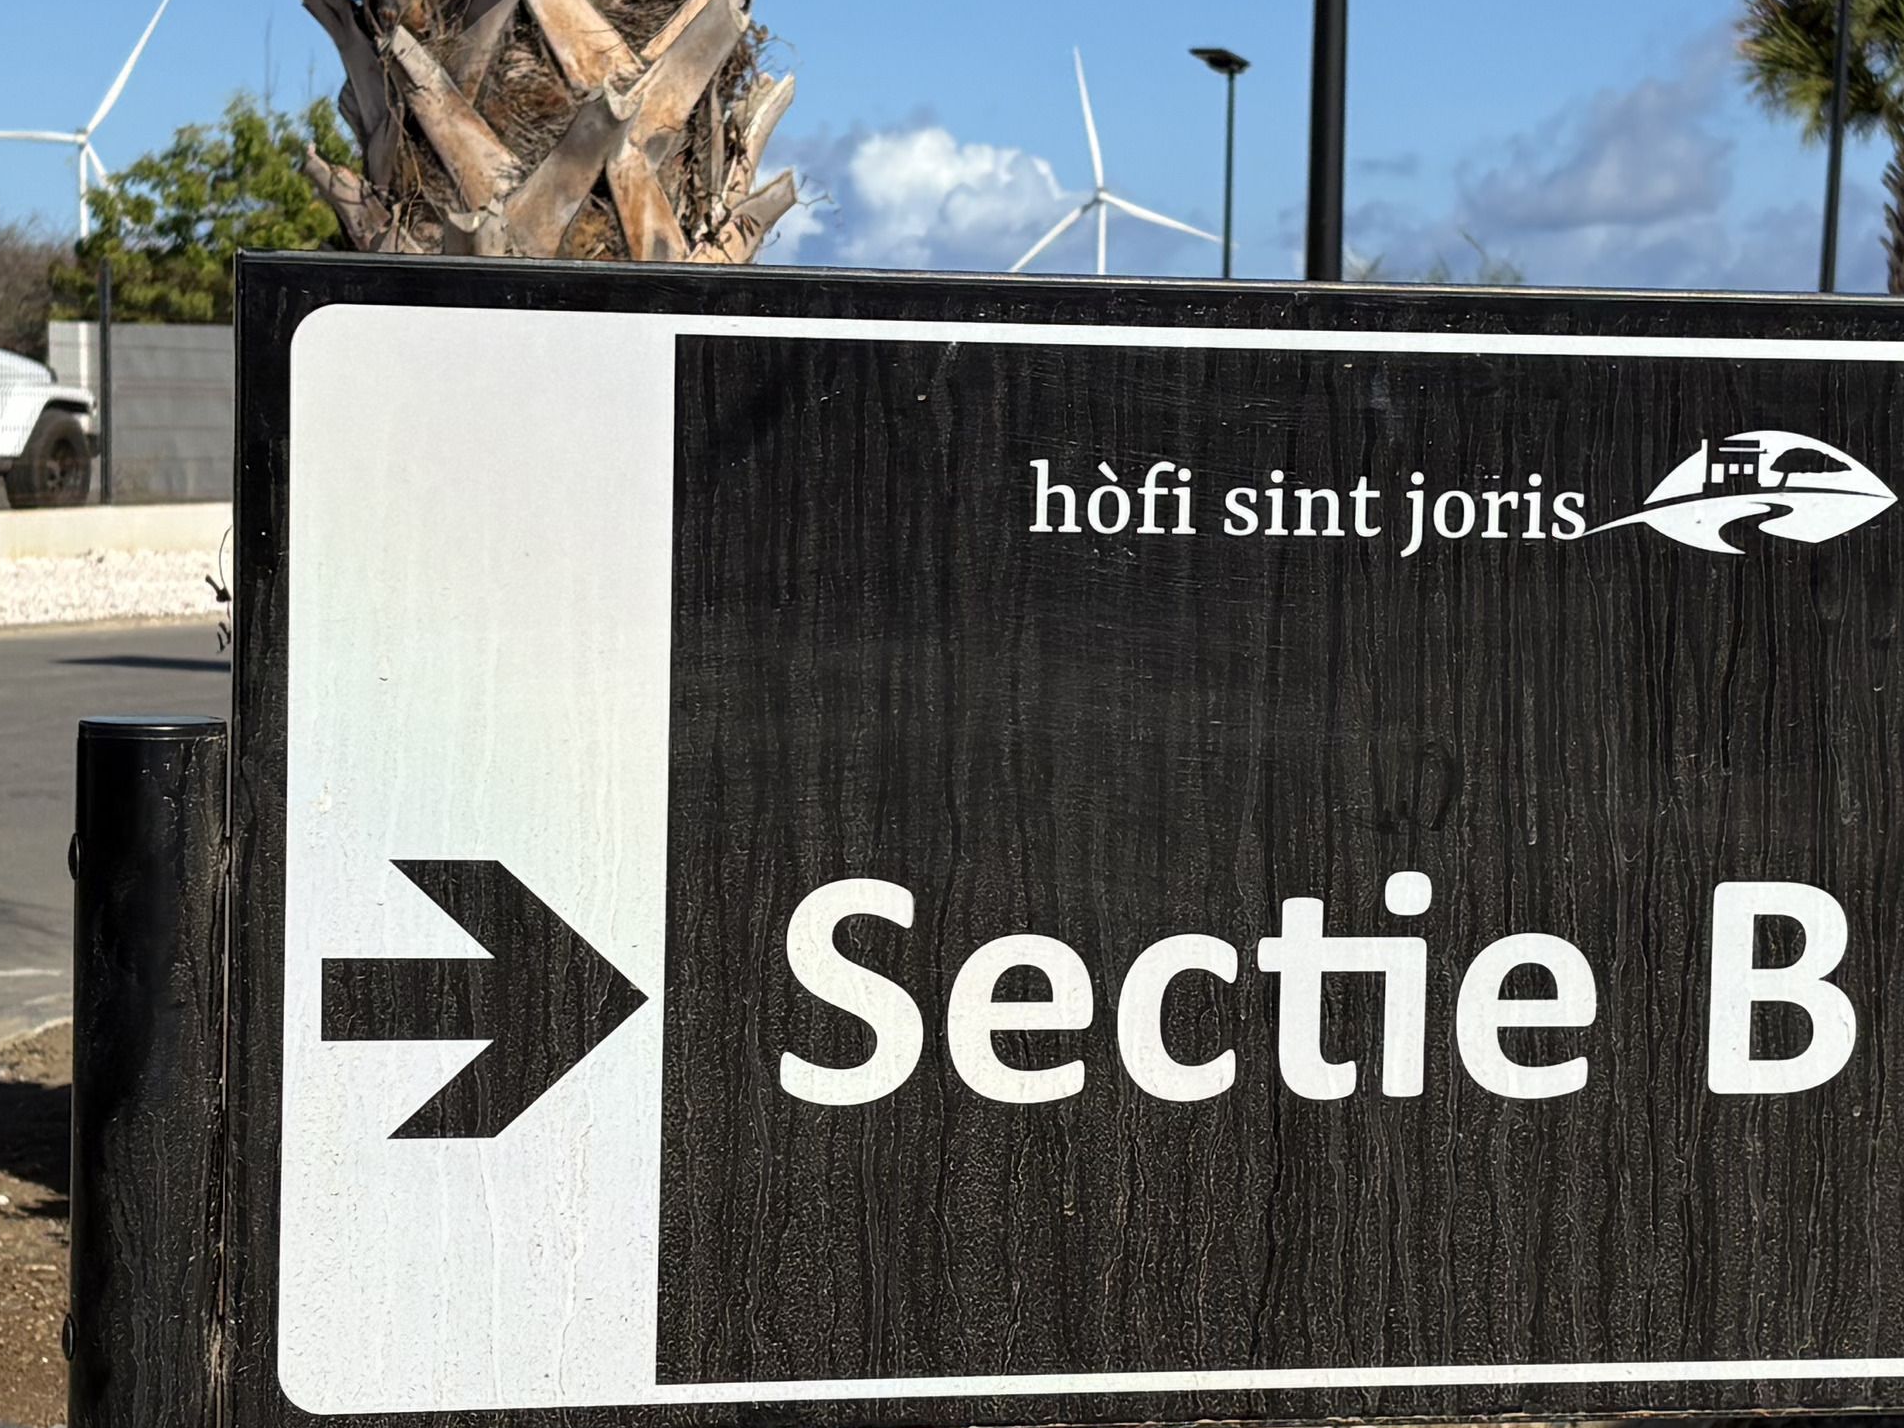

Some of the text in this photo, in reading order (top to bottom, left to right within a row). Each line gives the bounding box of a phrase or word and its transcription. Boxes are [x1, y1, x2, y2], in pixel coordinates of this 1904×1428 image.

[1028, 457, 1586, 559] hòfi sint joris
[778, 869, 1858, 1107] Sectie B
